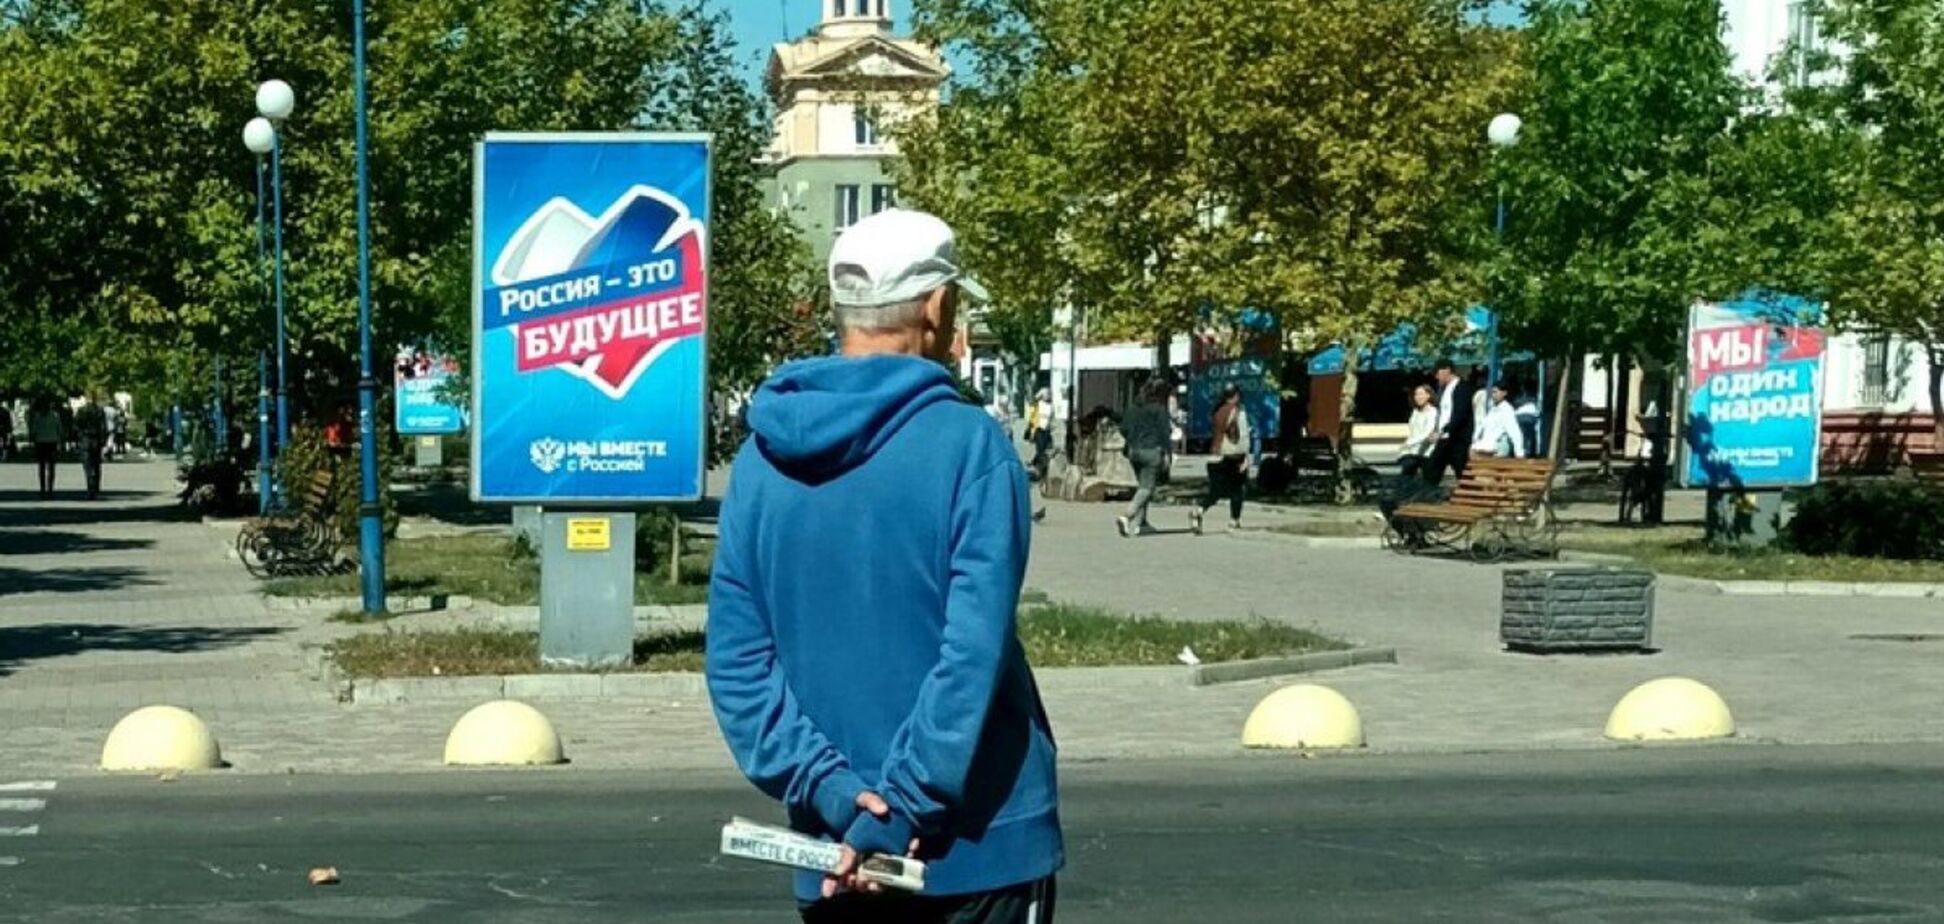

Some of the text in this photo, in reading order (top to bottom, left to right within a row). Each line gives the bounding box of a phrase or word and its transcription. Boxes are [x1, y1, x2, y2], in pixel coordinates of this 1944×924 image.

[524, 292, 702, 360] БУДУЩЕЕ
[1711, 368, 1797, 398] один
[1710, 394, 1810, 424] народ
[600, 441, 667, 456] ВМЕСТЕ
[797, 849, 840, 871] РОСС
